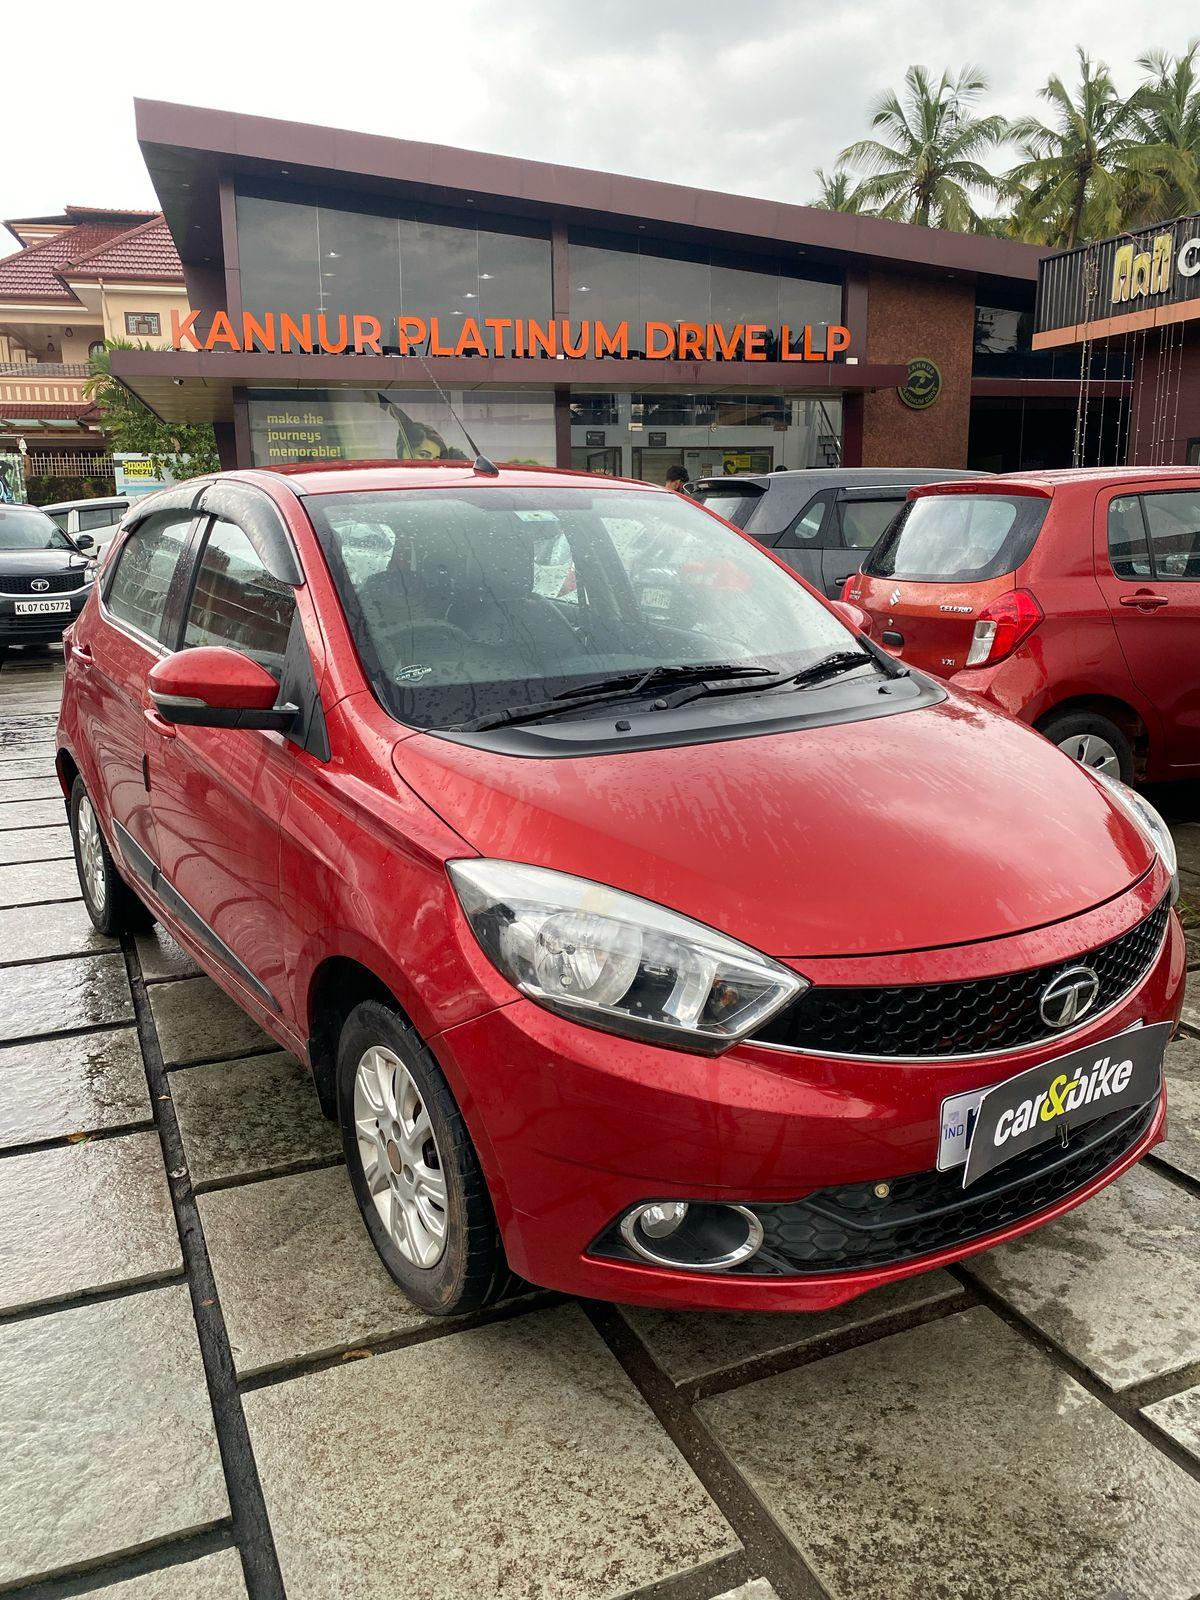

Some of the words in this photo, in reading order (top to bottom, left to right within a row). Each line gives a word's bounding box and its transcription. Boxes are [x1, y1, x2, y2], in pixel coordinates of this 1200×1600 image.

[170, 309, 383, 353] KANNUR
[399, 317, 628, 357] PLATINUM
[645, 321, 767, 361] DRIVE
[781, 324, 851, 361] LLP
[267, 412, 300, 424] make
[303, 413, 323, 424] the
[267, 429, 321, 443] journeys
[269, 446, 341, 457] memorable!
[122, 460, 153, 468] Smoot
[124, 468, 153, 477] Breezy
[17, 604, 26, 612] KL
[51, 602, 69, 611] 5772
[940, 605, 973, 614] CELERIO
[993, 1056, 1134, 1147] car&bike
[943, 1123, 965, 1141] IND
